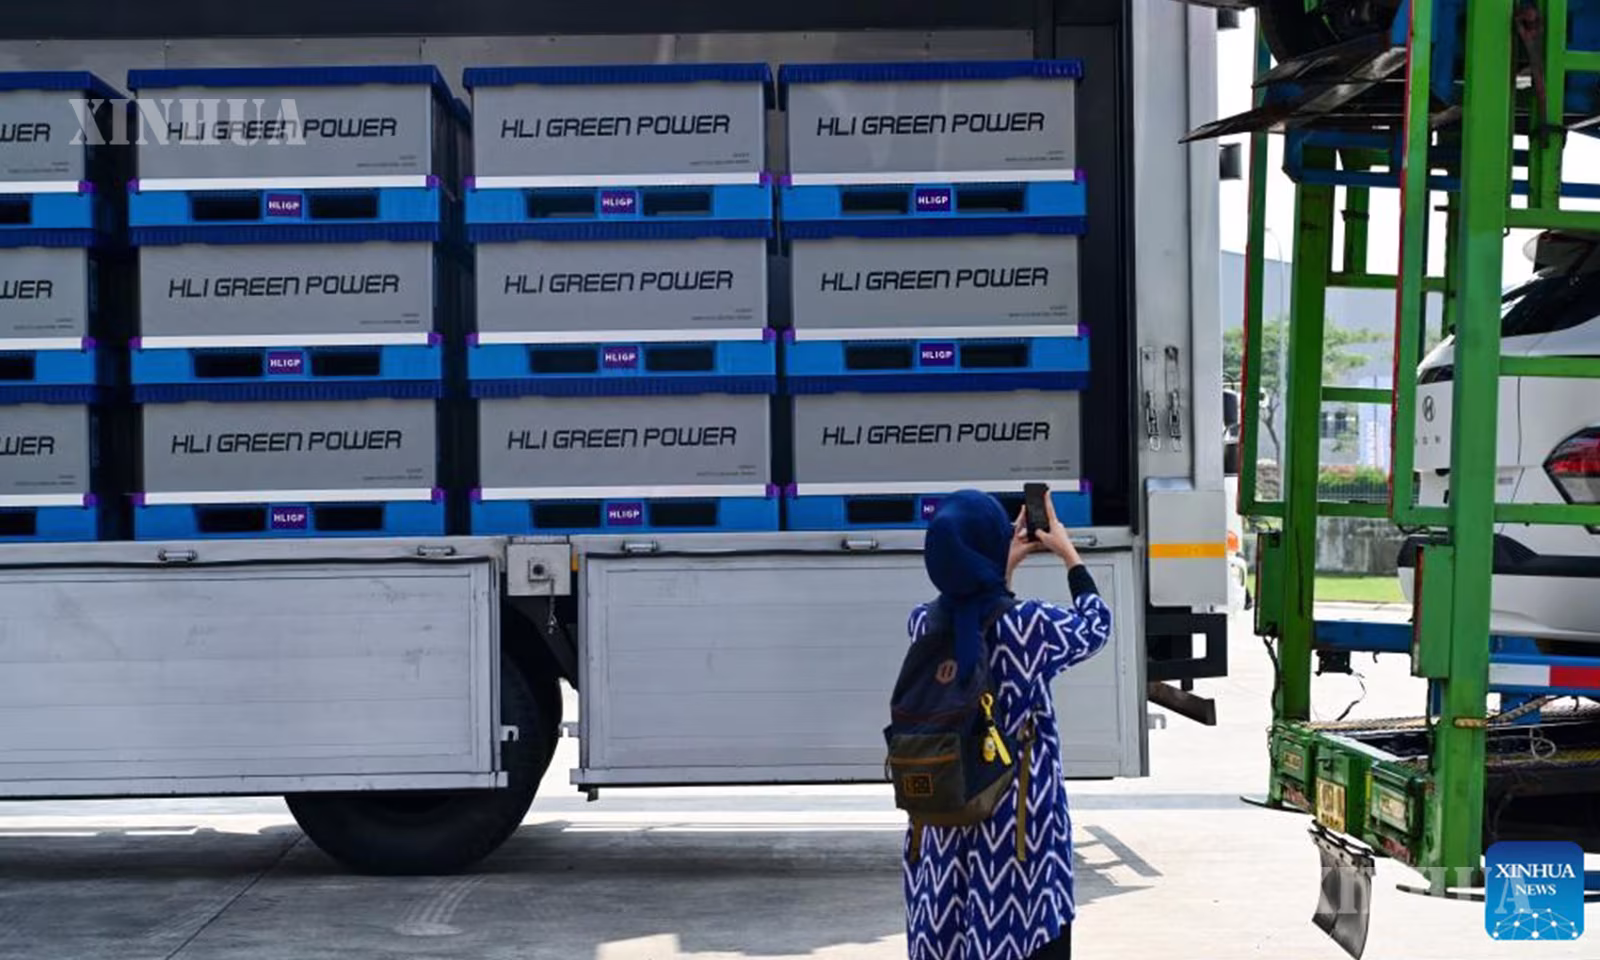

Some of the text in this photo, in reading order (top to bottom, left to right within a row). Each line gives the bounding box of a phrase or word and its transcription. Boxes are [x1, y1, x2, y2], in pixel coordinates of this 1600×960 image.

[303, 118, 397, 138] POWER
[501, 115, 731, 139] HLI GREEN POWER
[817, 112, 1045, 137] HLI GREEN POWER
[268, 201, 300, 210] HLIGP
[602, 198, 634, 207] HLIGP
[918, 196, 948, 204] HLIGP
[169, 274, 399, 298] HLI GREEN POWER
[505, 270, 733, 294] HLI GREEN POWER
[821, 267, 1049, 292] HLI GREEN POWER
[270, 358, 301, 367] HLIGP
[604, 353, 636, 362] HLIGP
[922, 351, 952, 359] HLIGP
[172, 430, 402, 454] HLI GREEN POWER
[508, 426, 737, 450] HLI GREEN POWER
[823, 422, 1050, 446] HLI GREEN POWER
[273, 514, 304, 522] HLIGP
[608, 510, 640, 519] HLIGP
